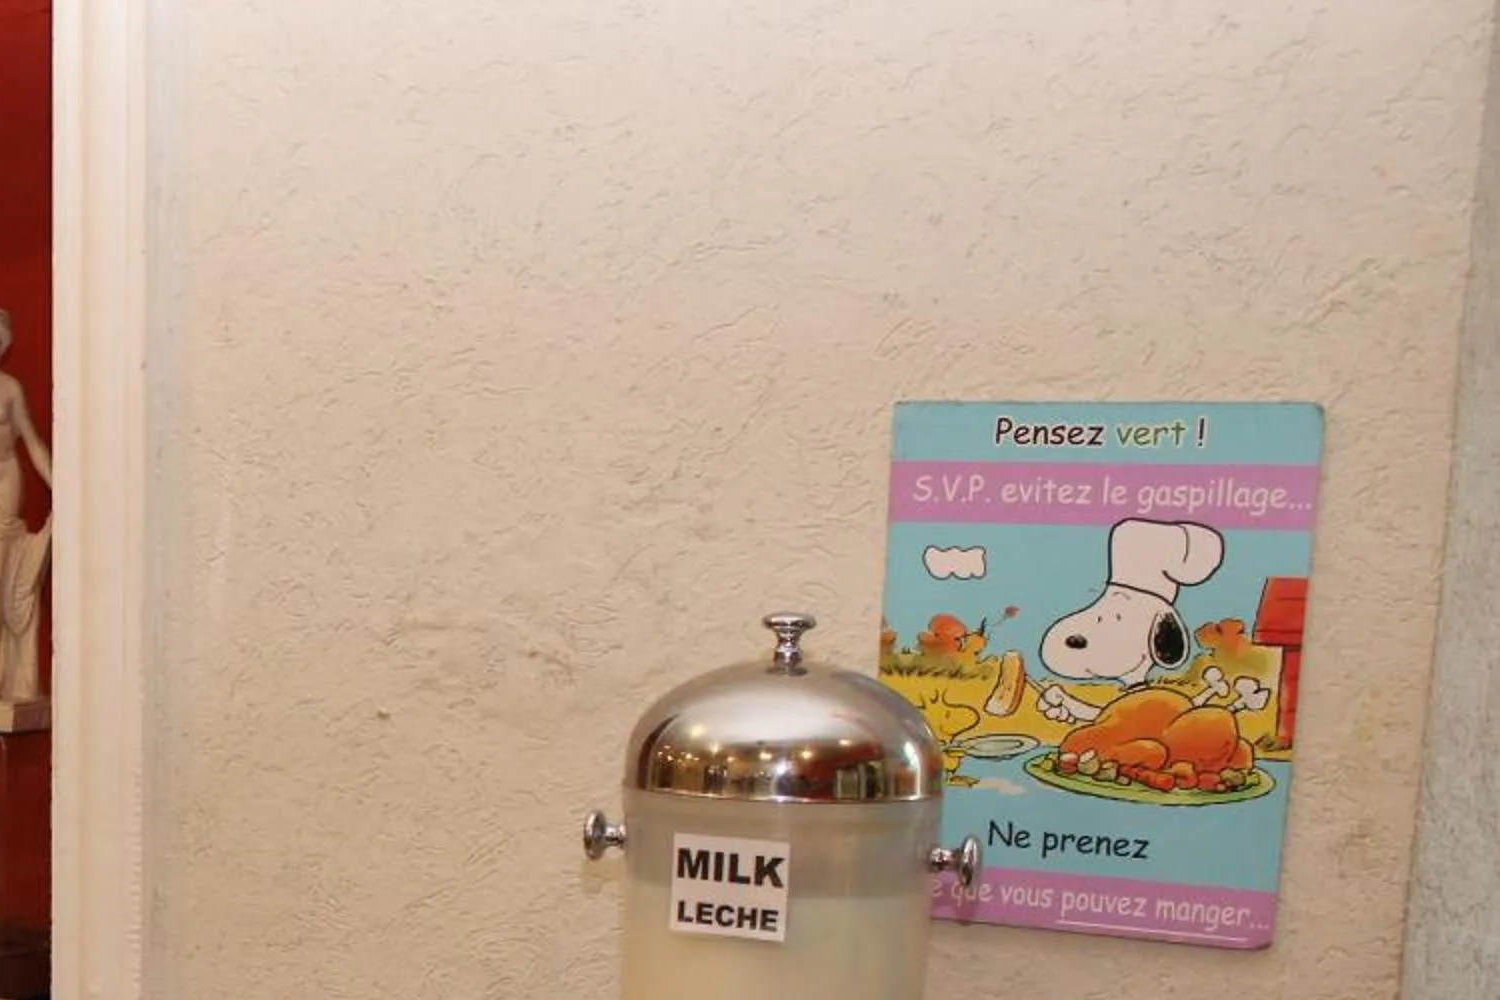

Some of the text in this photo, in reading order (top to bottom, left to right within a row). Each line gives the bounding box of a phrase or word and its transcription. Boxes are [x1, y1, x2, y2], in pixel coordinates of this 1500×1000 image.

[995, 417, 1206, 447] Pensez vert !
[912, 475, 1313, 517] S.V.P. evitez le gaspillage...
[987, 820, 1150, 860] Ne prenez
[677, 848, 786, 888] MILK
[677, 900, 779, 932] LECHE
[950, 881, 993, 908] que
[1000, 887, 1053, 908] vous
[1061, 890, 1148, 918] pouvez
[1155, 898, 1270, 931] manger...
